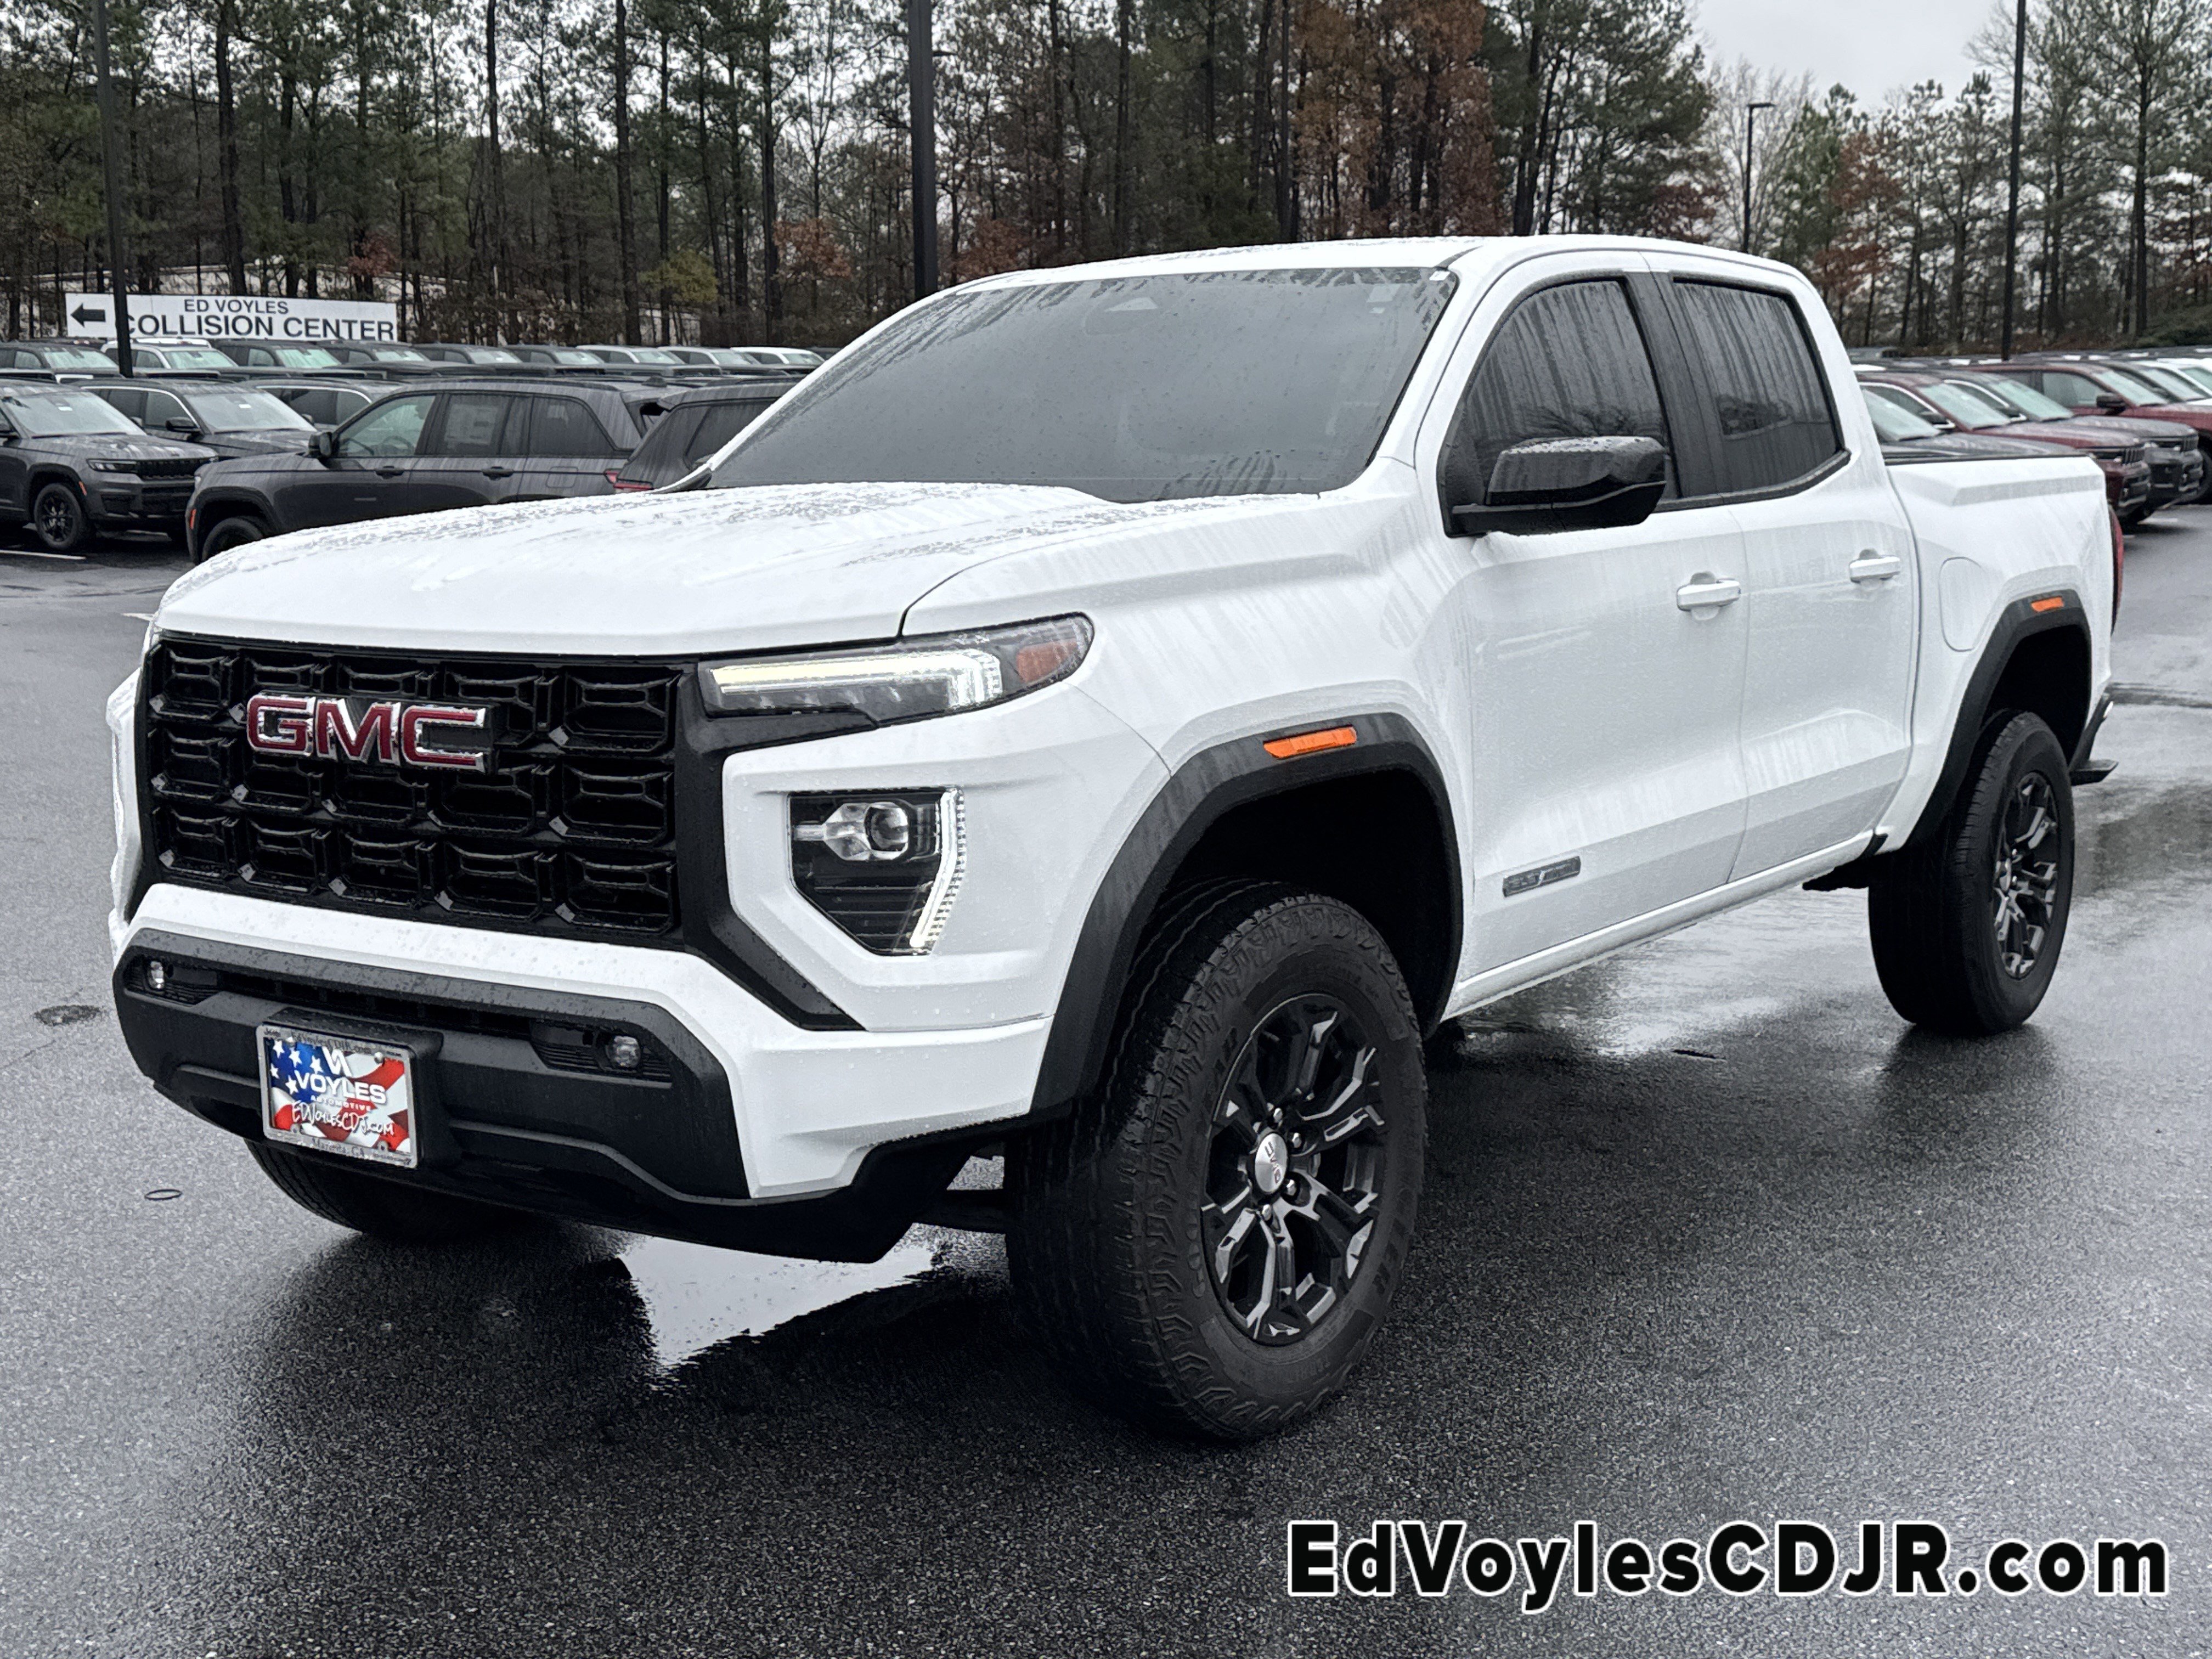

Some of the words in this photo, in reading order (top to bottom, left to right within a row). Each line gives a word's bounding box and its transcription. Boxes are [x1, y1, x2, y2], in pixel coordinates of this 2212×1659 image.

[184, 298, 210, 313] ED
[215, 299, 289, 314] VOYLES
[283, 316, 394, 341] CENTER
[246, 694, 486, 772] GMC
[294, 1070, 387, 1104] VOYLES
[311, 1095, 371, 1111] AUTOMOTIVE
